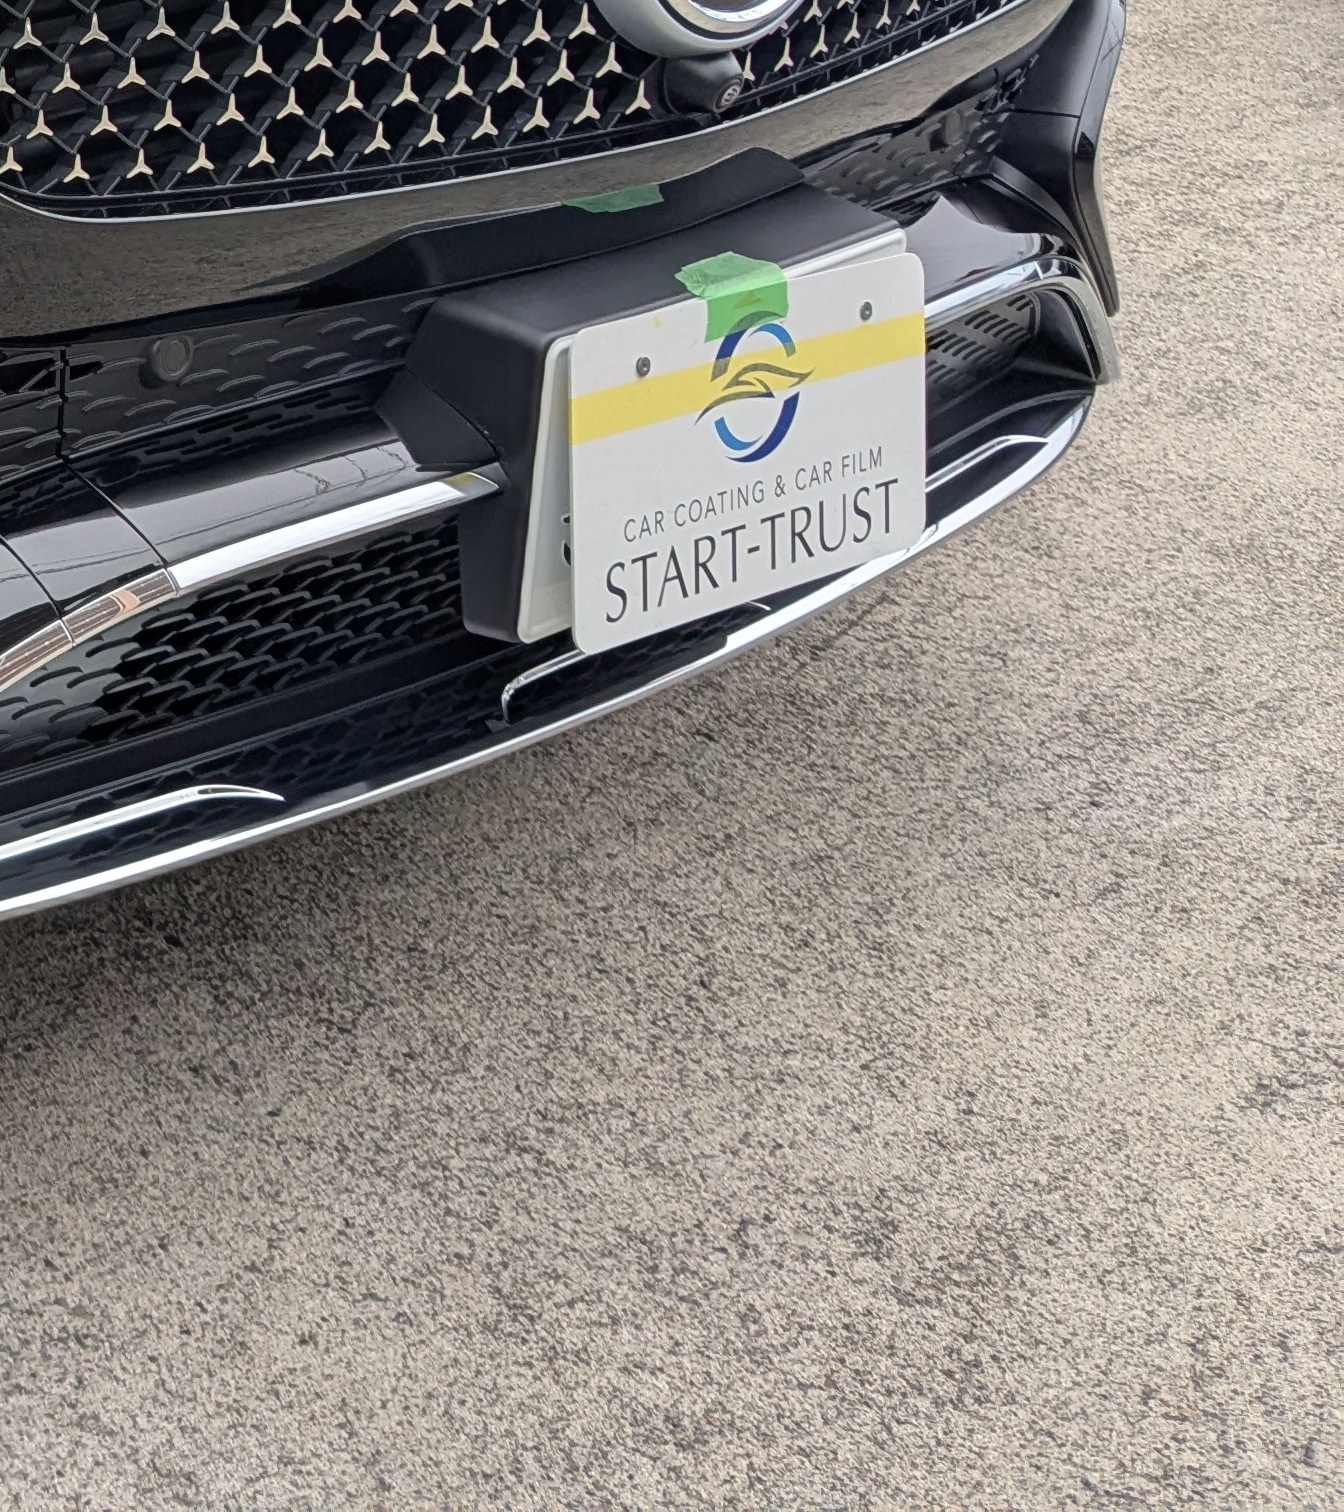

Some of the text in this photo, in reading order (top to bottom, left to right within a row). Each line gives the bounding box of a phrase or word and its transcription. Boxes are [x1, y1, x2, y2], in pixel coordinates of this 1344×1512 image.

[605, 477, 899, 624] START-TRUST
[623, 445, 883, 543] CAR COATING & CAR FILM
